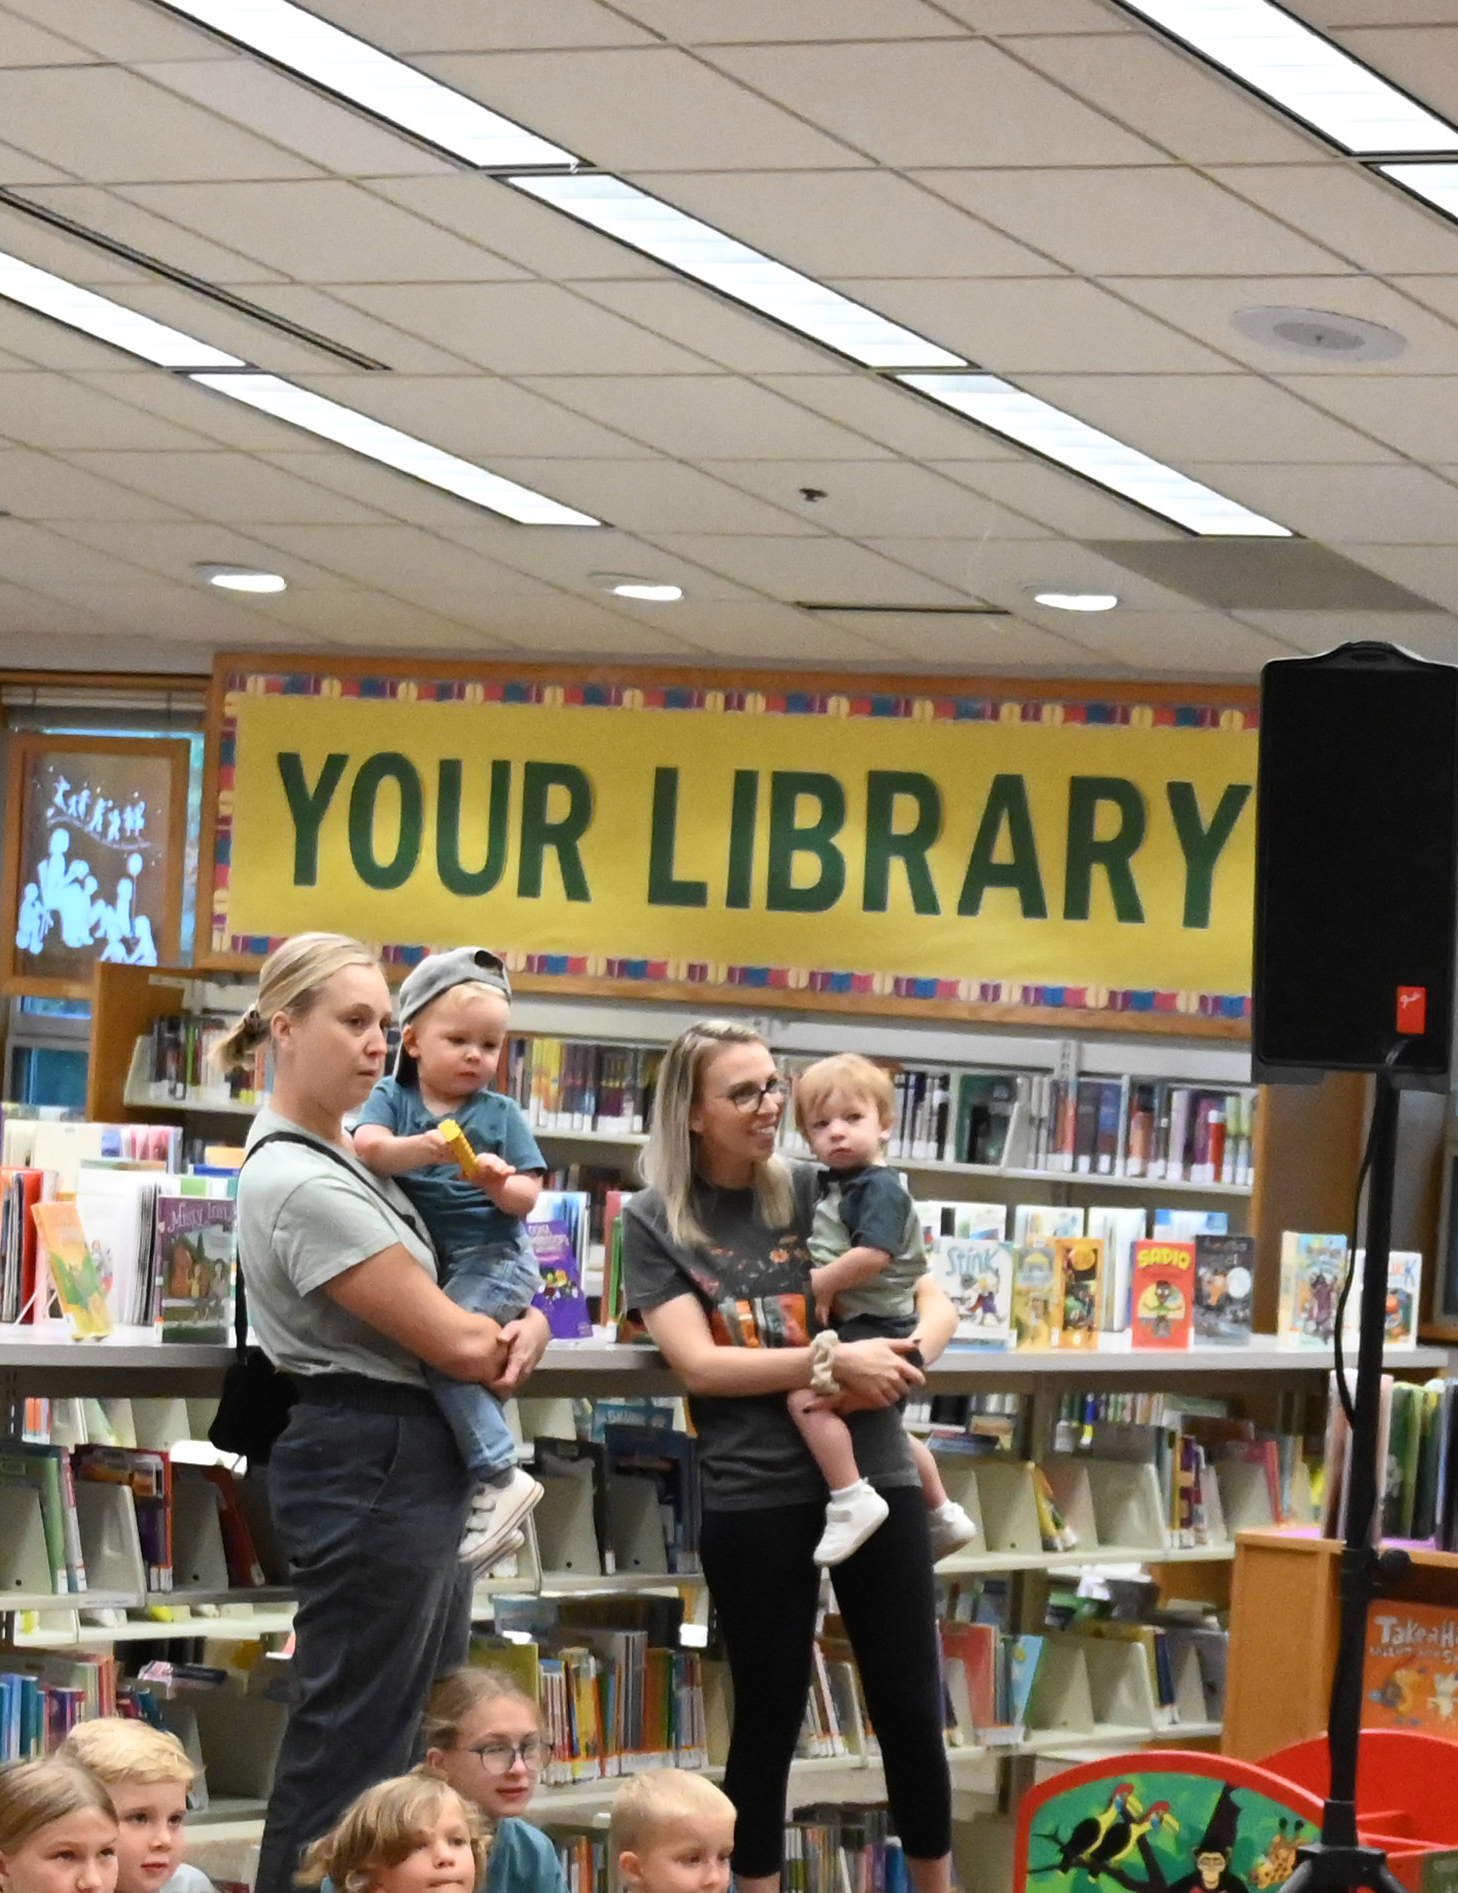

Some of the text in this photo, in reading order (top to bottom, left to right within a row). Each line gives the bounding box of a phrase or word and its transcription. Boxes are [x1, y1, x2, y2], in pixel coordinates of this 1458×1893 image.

[276, 750, 1253, 930] YOUR LIBRARY
[945, 1246, 999, 1277] Stink
[1374, 1615, 1426, 1645] Take
